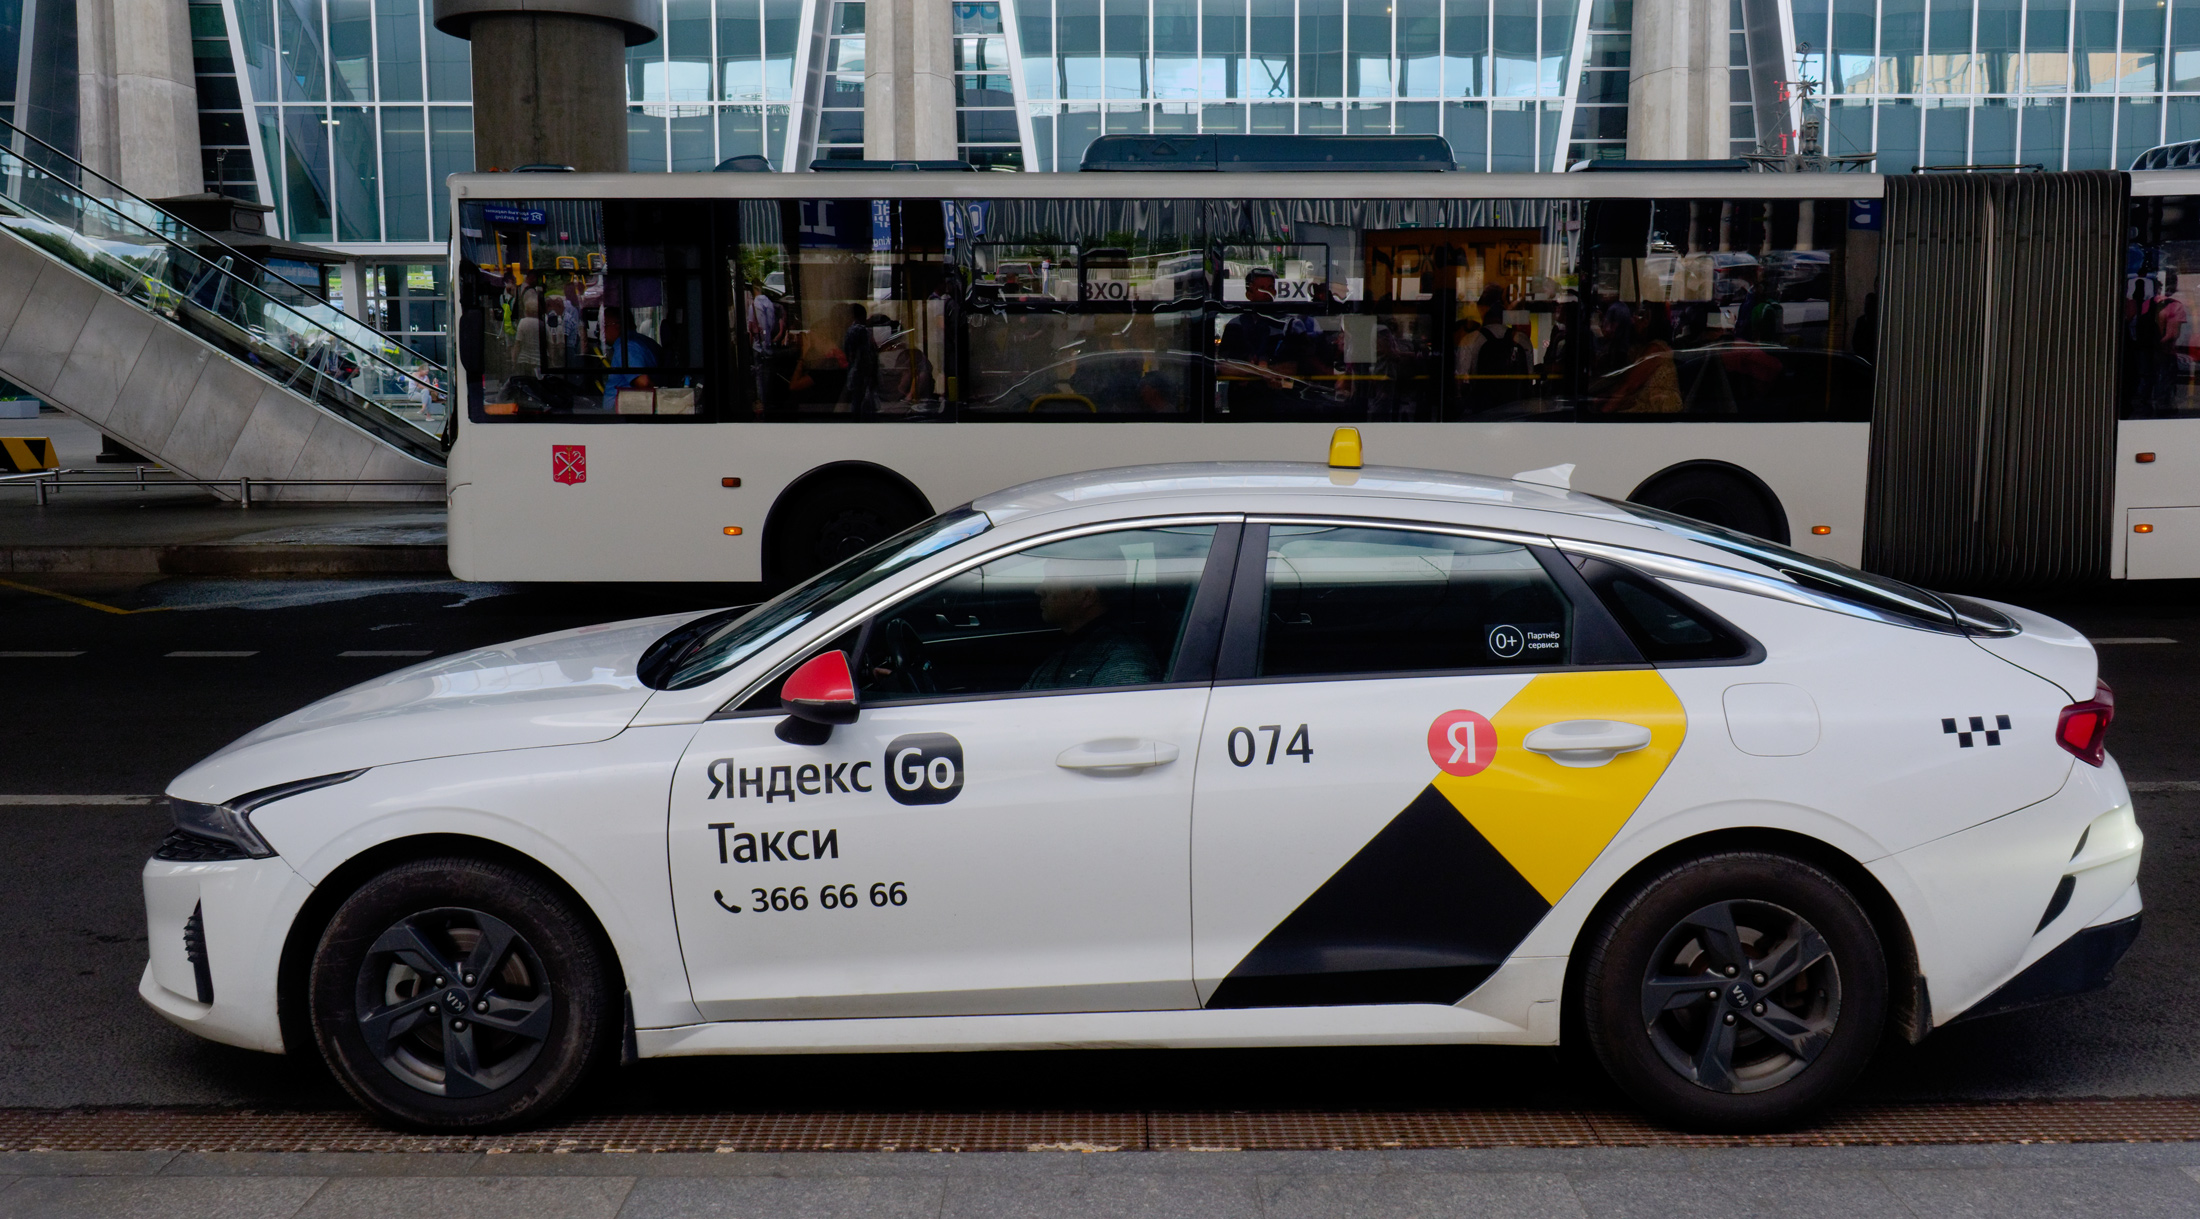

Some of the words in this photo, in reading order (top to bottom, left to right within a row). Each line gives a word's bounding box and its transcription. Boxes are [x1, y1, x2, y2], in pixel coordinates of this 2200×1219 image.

[1495, 633, 1518, 650] 0+
[1527, 631, 1561, 641] Партнёр
[1527, 642, 1560, 651] сервиса
[1227, 723, 1314, 767] 074
[1447, 721, 1476, 764] Я
[707, 757, 873, 803] Яндекс
[891, 745, 958, 793] Go
[708, 822, 839, 864] Такси
[751, 885, 809, 913] 366
[819, 883, 859, 910] 66
[869, 881, 908, 908] 66
[446, 991, 466, 1012] KIA
[1732, 984, 1749, 1007] KIA
